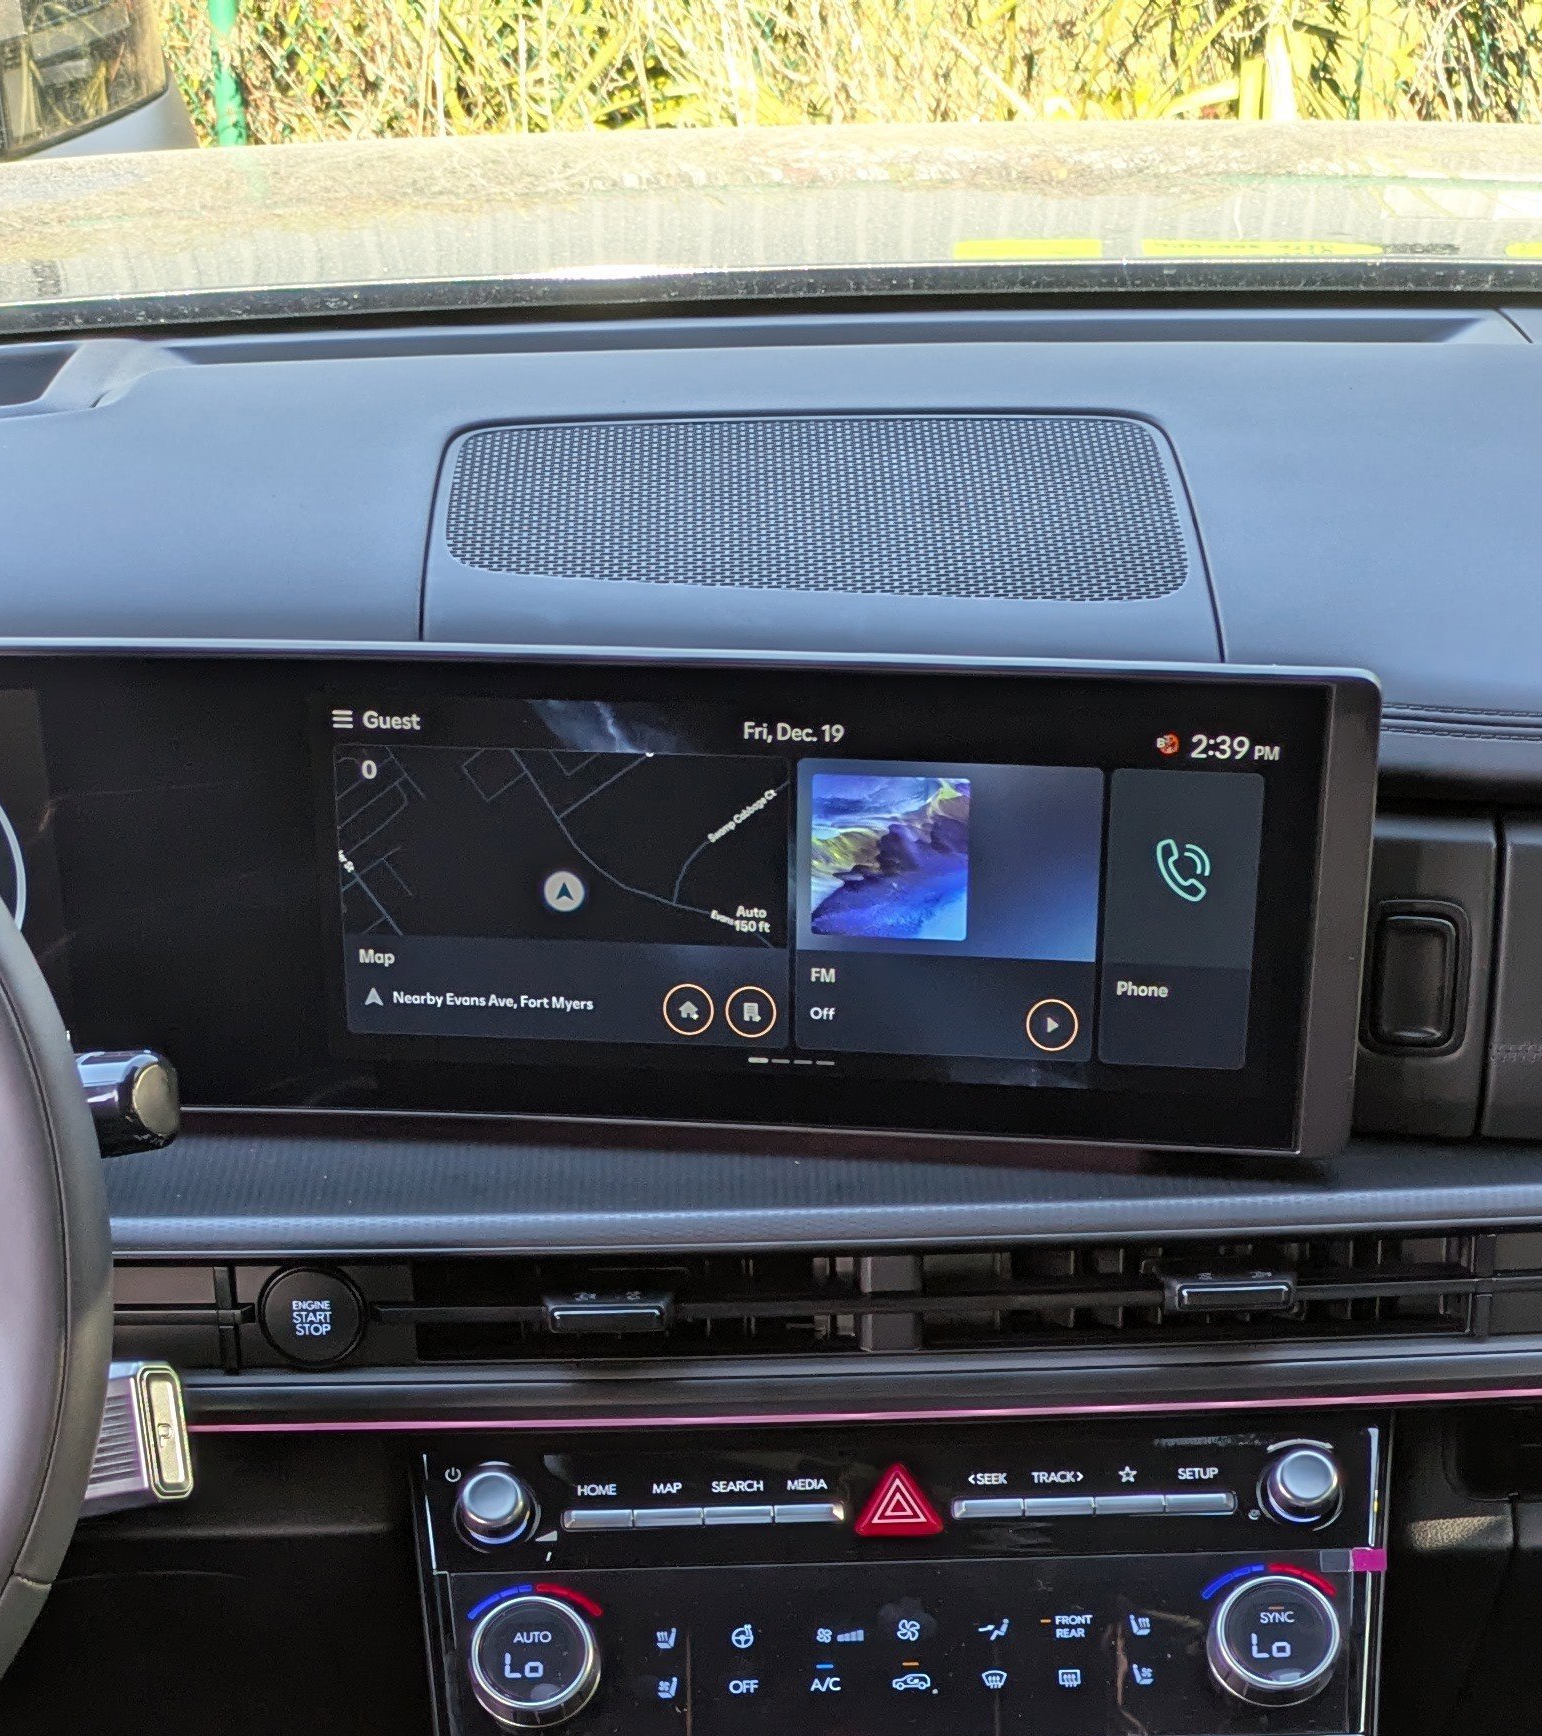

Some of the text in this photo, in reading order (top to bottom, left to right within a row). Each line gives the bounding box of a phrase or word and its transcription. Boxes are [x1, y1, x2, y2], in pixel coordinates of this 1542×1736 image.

[362, 710, 421, 730] Guest
[743, 721, 845, 743] Fri, Dec. 19
[1190, 734, 1280, 761] 2:39 PM
[362, 760, 377, 779] 0
[707, 821, 736, 843] Swamp
[736, 905, 767, 918] Auto
[734, 920, 770, 933] 150 ft
[359, 949, 395, 967] Map
[810, 968, 836, 983] FM
[1116, 981, 1169, 998] Phone
[392, 991, 594, 1012] Nearby Evans Ave, Fort Myers
[810, 1007, 836, 1020] Off
[292, 1300, 331, 1310] ENGINE
[292, 1311, 332, 1323] START
[295, 1323, 331, 1336] STOP
[157, 1422, 174, 1448] P
[577, 1484, 617, 1497] HOME
[652, 1482, 682, 1494] MAP
[711, 1480, 764, 1493] SEARCH
[787, 1479, 828, 1491] MEDIA
[1178, 1467, 1219, 1480] SETUP
[1054, 1614, 1093, 1625] FRONT
[1259, 1611, 1295, 1624] SYNC
[513, 1631, 551, 1644] AUTO
[1055, 1628, 1085, 1639] REAR
[729, 1680, 759, 1694] OFF
[810, 1677, 841, 1692] A/C
